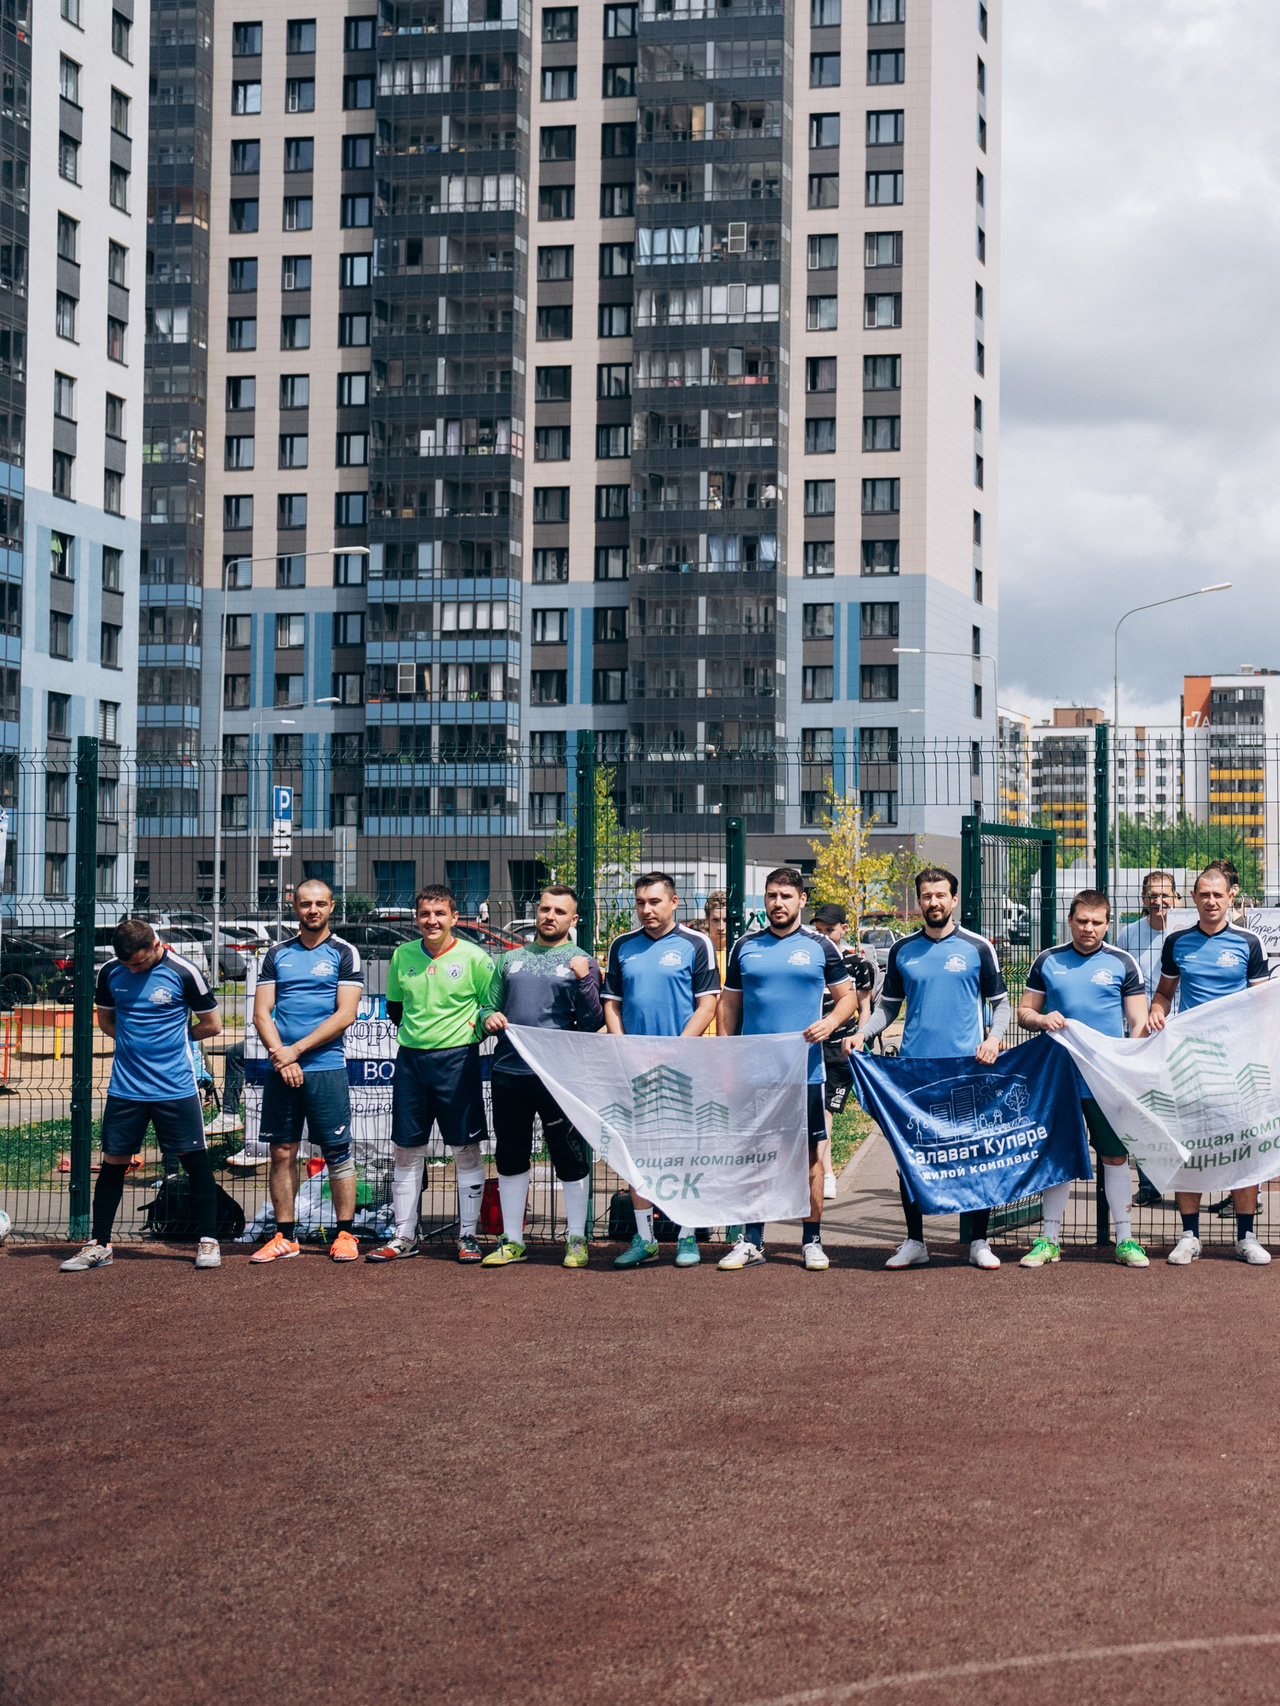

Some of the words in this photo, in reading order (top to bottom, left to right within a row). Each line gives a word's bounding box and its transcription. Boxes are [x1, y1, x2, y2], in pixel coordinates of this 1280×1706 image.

[279, 790, 290, 817] P
[689, 1150, 778, 1168] компания
[907, 1144, 980, 1165] Салават
[983, 1125, 1048, 1156] Купере
[922, 1166, 966, 1180] жилой
[969, 1150, 1040, 1174] комплекс
